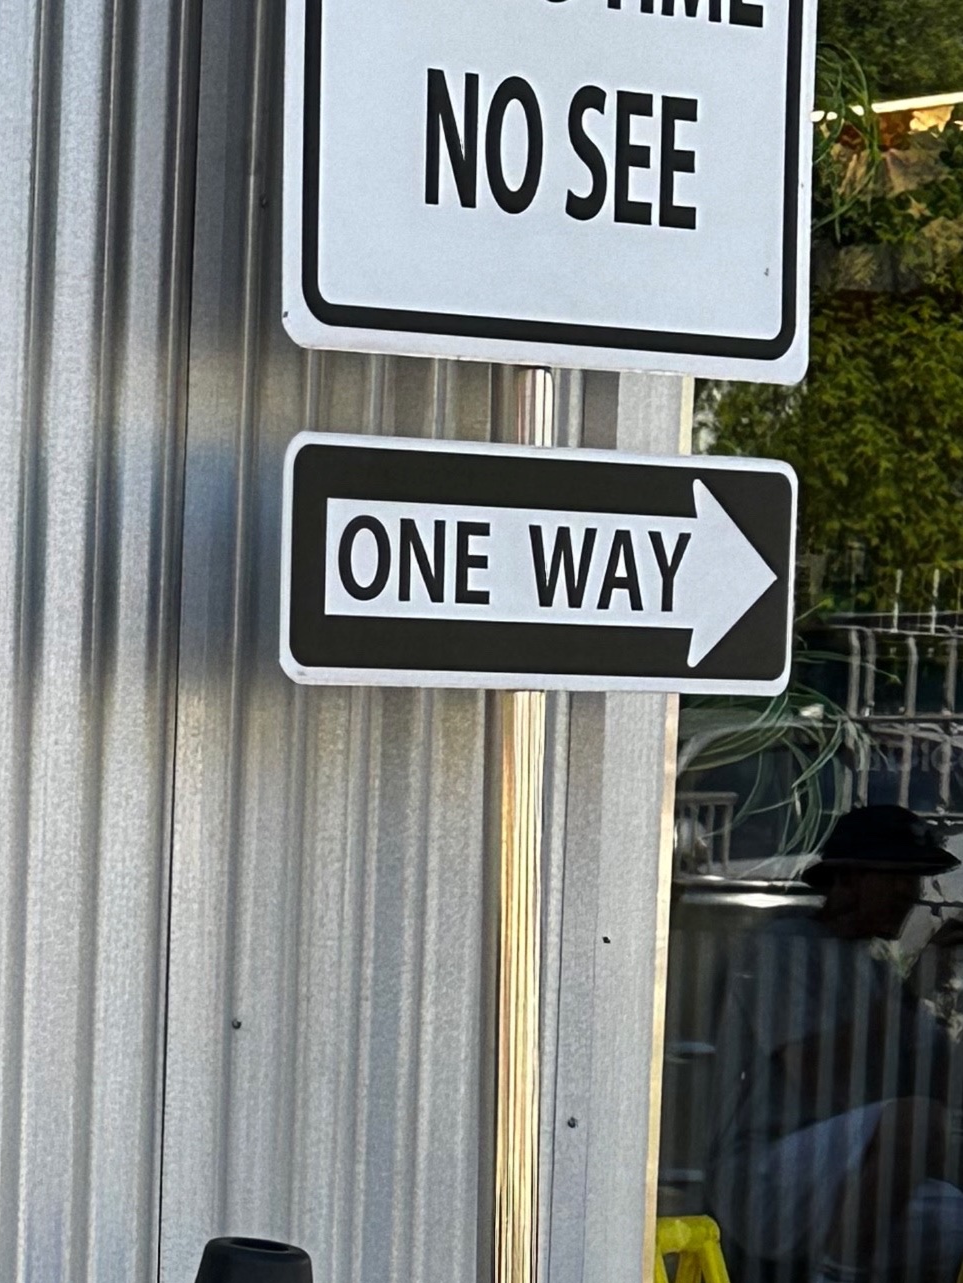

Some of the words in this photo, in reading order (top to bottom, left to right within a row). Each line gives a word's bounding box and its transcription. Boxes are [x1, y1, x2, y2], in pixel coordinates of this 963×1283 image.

[425, 68, 543, 214] NO
[565, 85, 698, 229] SEE
[338, 515, 490, 605] ONE
[529, 524, 692, 612] WAY
